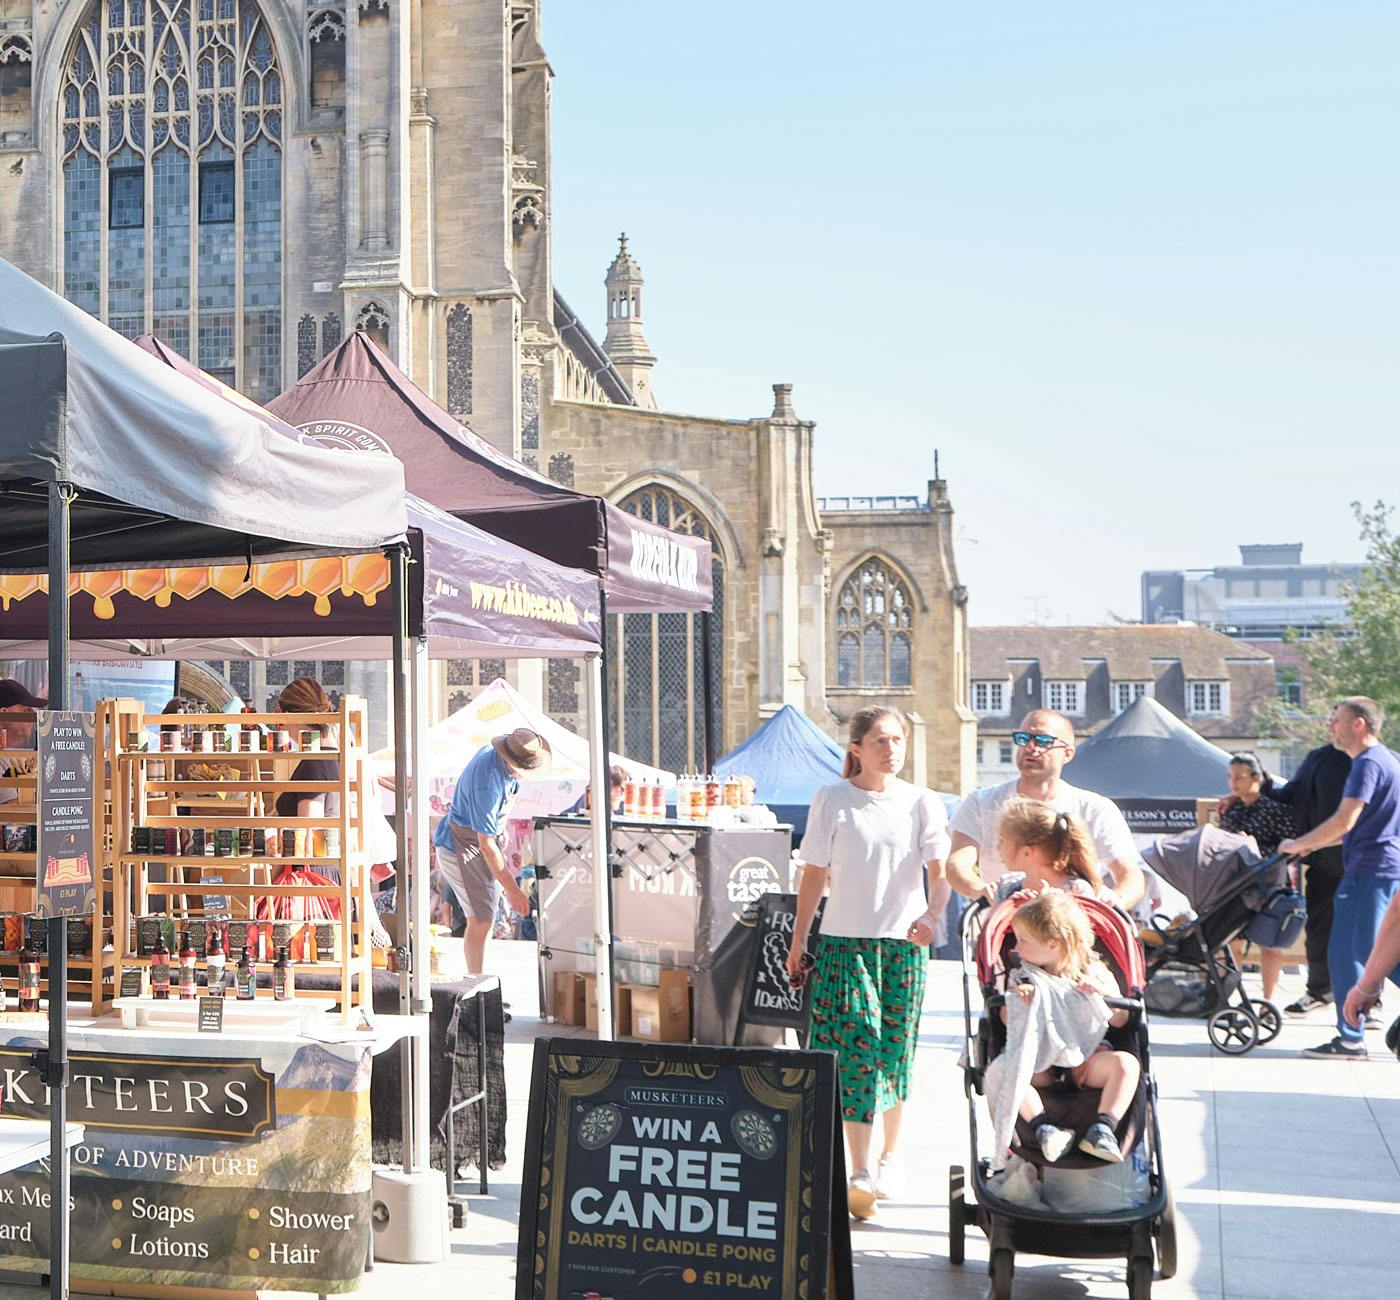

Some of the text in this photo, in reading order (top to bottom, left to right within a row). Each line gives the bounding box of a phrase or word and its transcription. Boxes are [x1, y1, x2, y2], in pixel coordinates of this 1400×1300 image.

[314, 424, 358, 437] SPIRIT
[53, 727, 83, 737] PLAY TO WIN
[50, 741, 55, 751] A
[55, 741, 66, 751] FREE
[60, 771, 76, 781] DARTS
[52, 805, 84, 816] CANDLE PONG
[739, 865, 770, 884] great
[726, 880, 782, 902] taste
[754, 988, 789, 1010] IDEAS
[630, 1089, 726, 1107] MUSKETEERS
[631, 1115, 722, 1144] WIN A
[75, 1146, 259, 1177] OF ADVENTURE
[608, 1144, 741, 1193] FREE
[21, 1186, 75, 1211] Mes
[131, 1197, 195, 1223] Soaps
[269, 1205, 355, 1231] Shower
[570, 1186, 778, 1240] CANDLE
[129, 1234, 209, 1259] Lotions
[269, 1243, 320, 1265] Hair
[568, 1230, 777, 1263] DARTS CANDLE PONG
[601, 1266, 637, 1275] CUSTOMER
[703, 1270, 773, 1290] £1 PLAY
